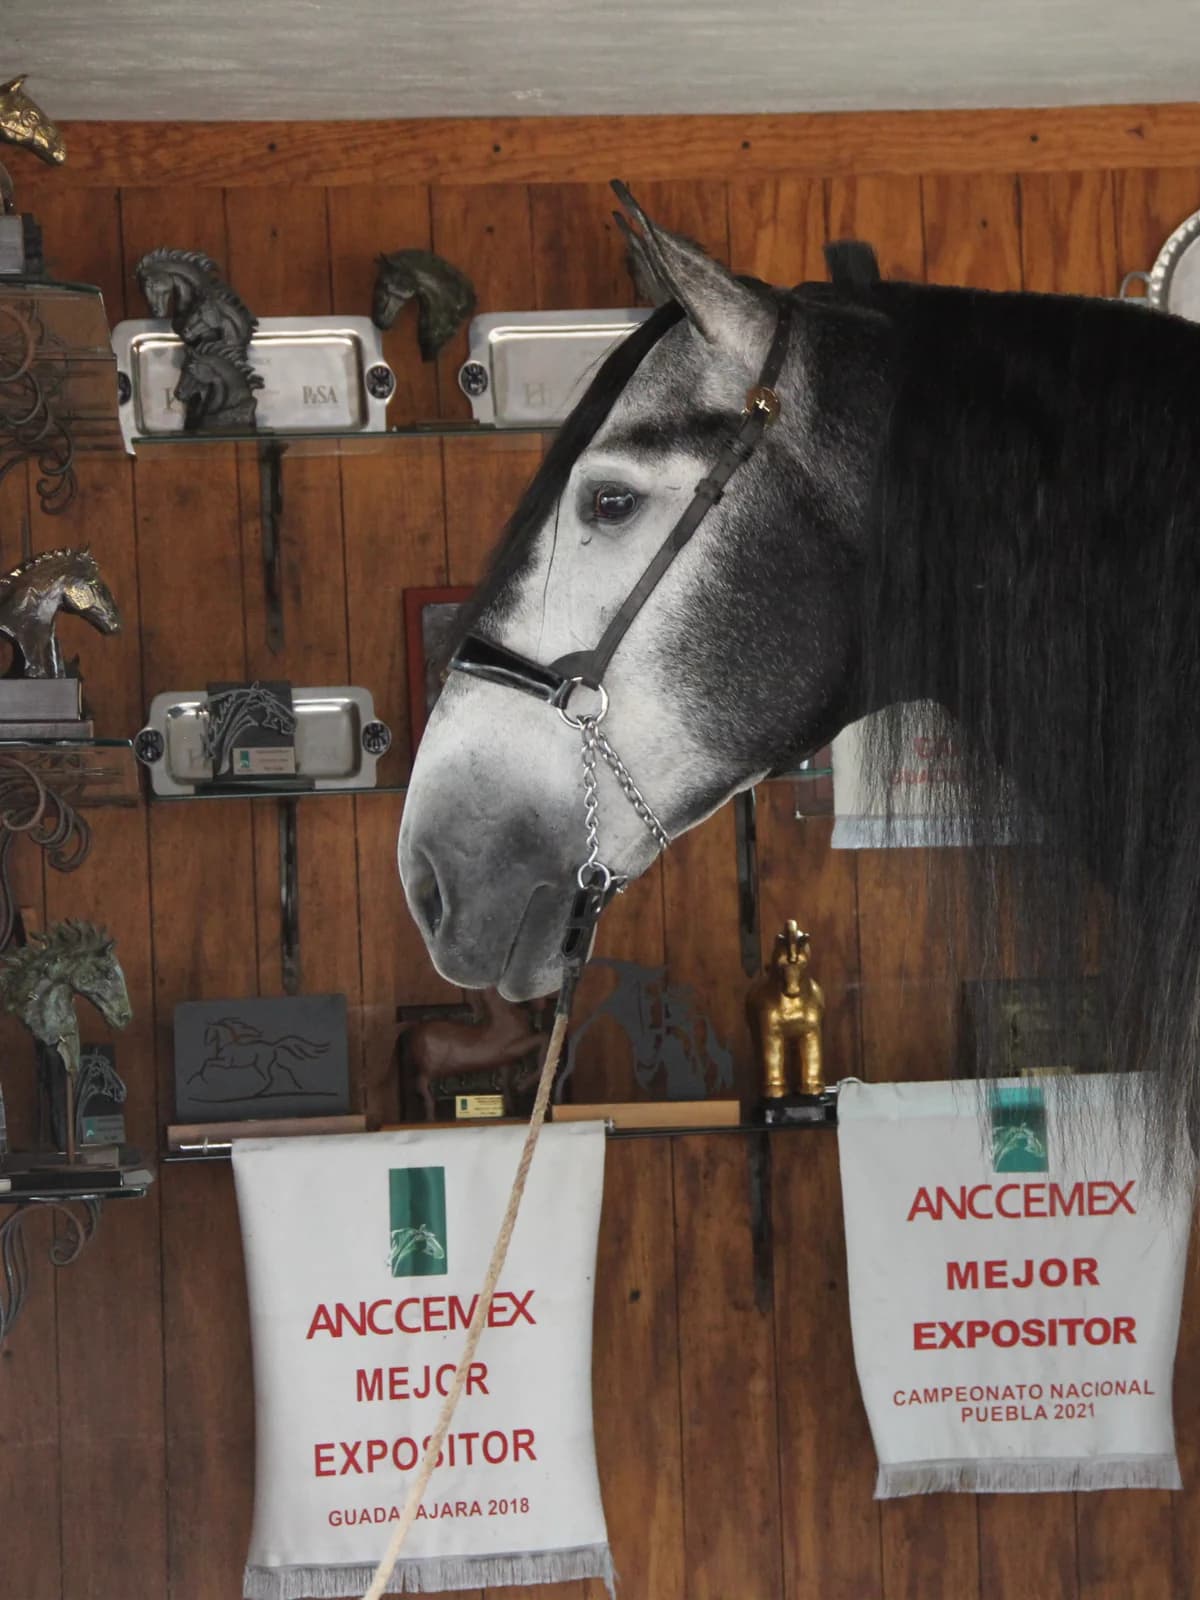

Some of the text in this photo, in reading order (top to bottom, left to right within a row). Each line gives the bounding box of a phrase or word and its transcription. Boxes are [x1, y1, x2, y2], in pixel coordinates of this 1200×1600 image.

[906, 1180, 1137, 1223] ANCCEMEX
[946, 1257, 1100, 1291] MEJOR
[306, 1289, 536, 1340] ANCCEMEX
[912, 1316, 1137, 1351] EXPOSITOR
[356, 1361, 489, 1402] MEJOR
[893, 1379, 1155, 1407] CAMPEONATO NACIONAL
[961, 1403, 1096, 1423] PUEBLA 2021
[328, 1497, 530, 1527] GUADAAJARA 2018
